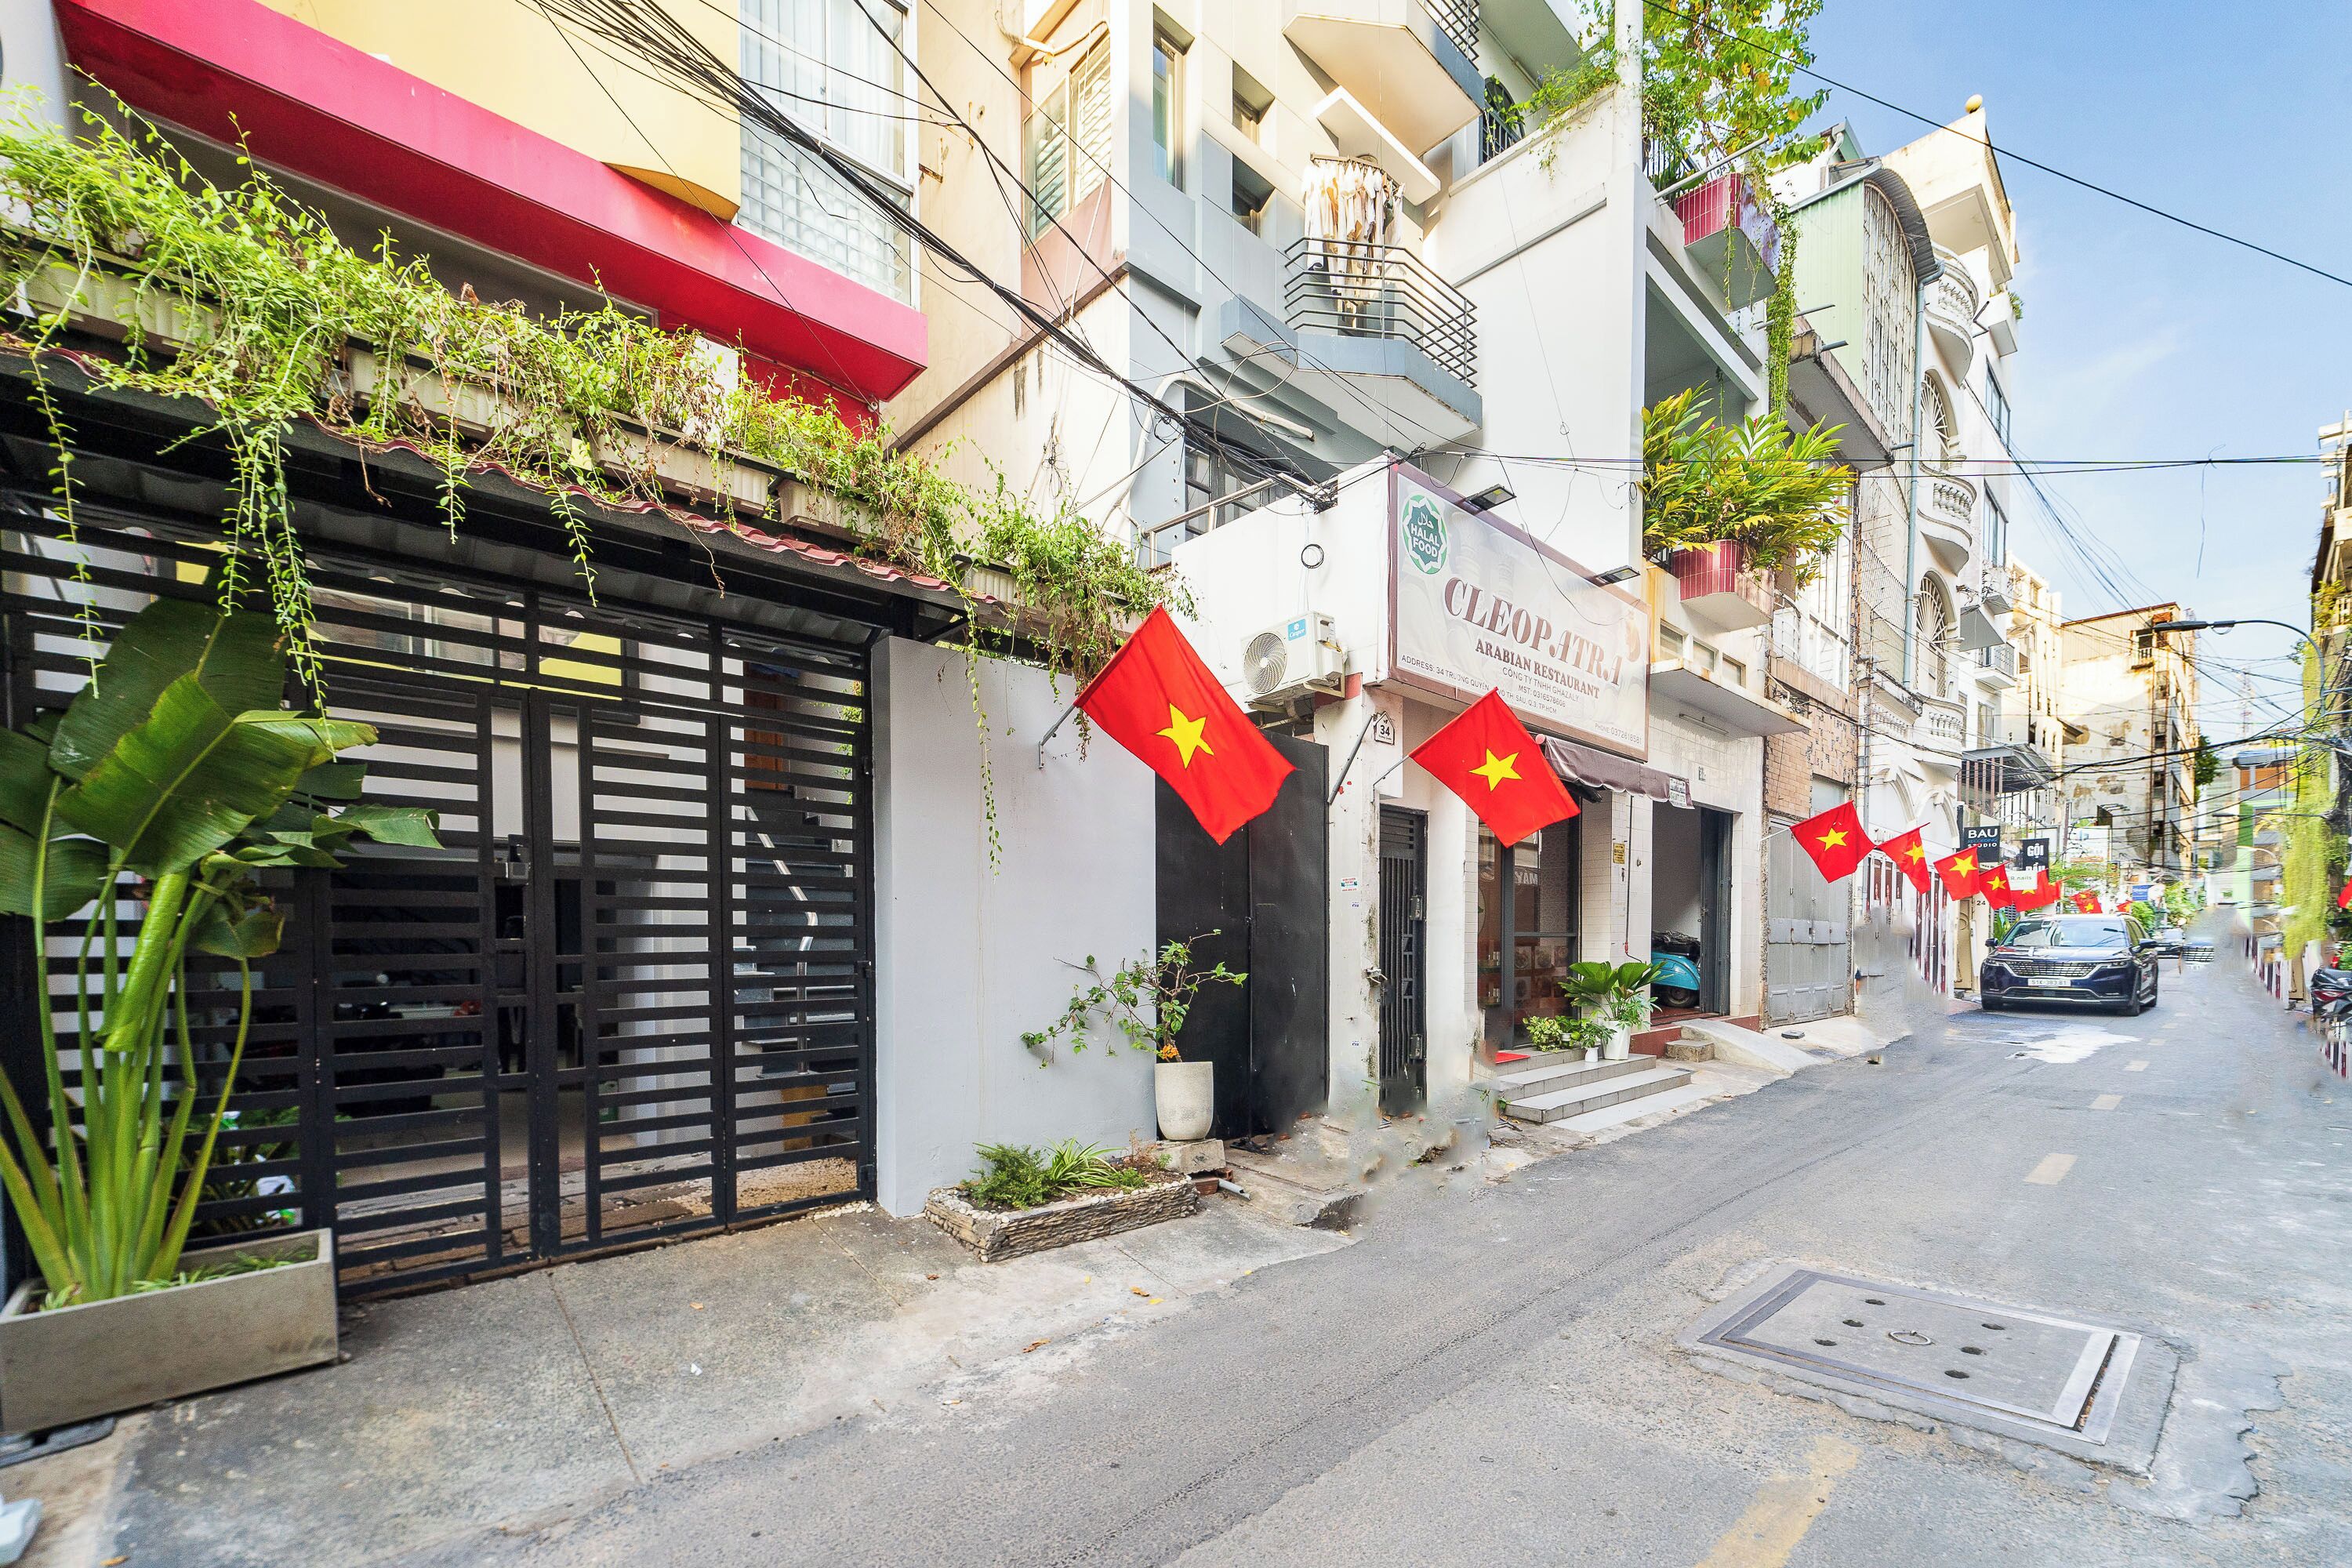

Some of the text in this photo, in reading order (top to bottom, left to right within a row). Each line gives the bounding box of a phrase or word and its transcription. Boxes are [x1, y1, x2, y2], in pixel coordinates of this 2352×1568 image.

[1417, 511, 1434, 529] حلال
[1411, 524, 1440, 547] HALAL
[1413, 537, 1437, 557] FOOD
[1444, 577, 1623, 686] CLEOPATRA
[1401, 655, 1435, 672] ADDRESS:
[1436, 666, 1444, 676] 34
[1475, 639, 1599, 699] ARABIAN RESTAURANT
[1518, 684, 1532, 696] MST:
[1524, 675, 1533, 684] TY
[1533, 677, 1551, 691] TNHH
[1552, 684, 1579, 702] GHAZALY
[1380, 724, 1390, 736] 34
[1968, 829, 1998, 838] BAU
[2027, 843, 2044, 858] GỘI
